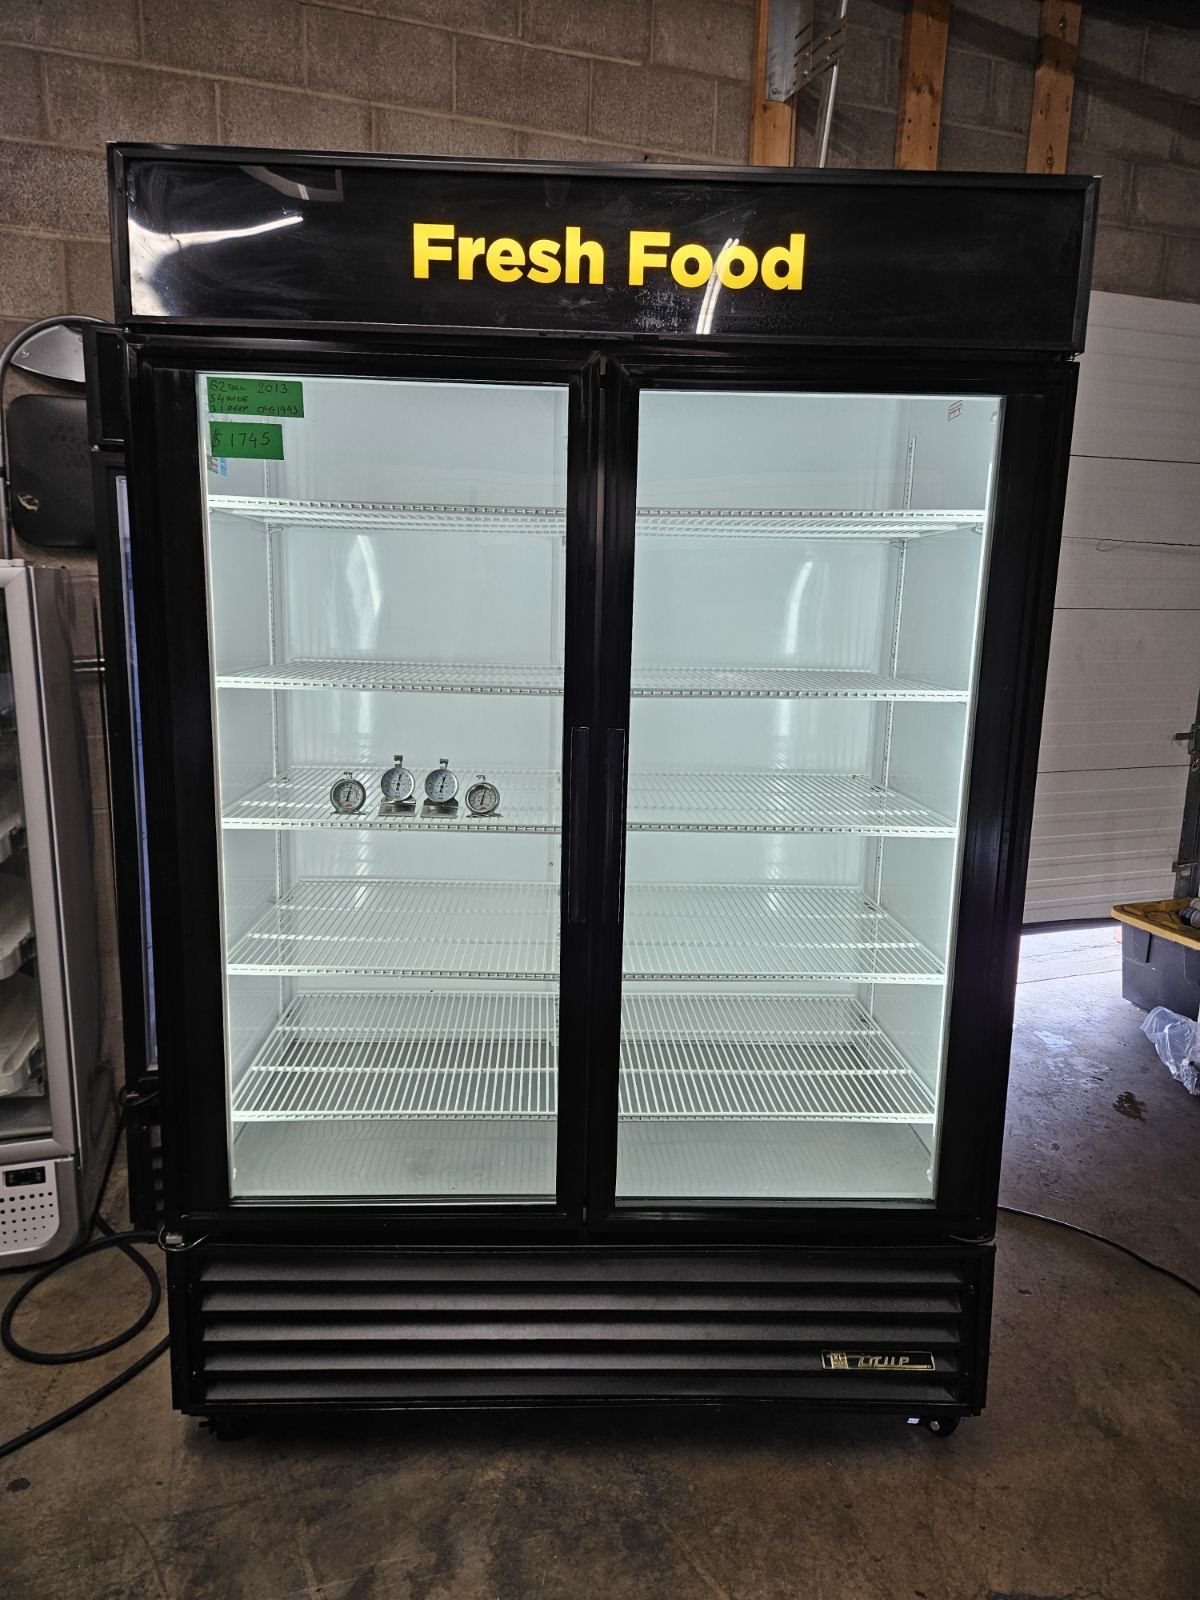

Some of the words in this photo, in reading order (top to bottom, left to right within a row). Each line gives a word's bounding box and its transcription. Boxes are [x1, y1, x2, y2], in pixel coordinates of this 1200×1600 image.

[413, 223, 605, 284] Fresh
[628, 230, 806, 291] Food
[257, 381, 288, 394] 2013
